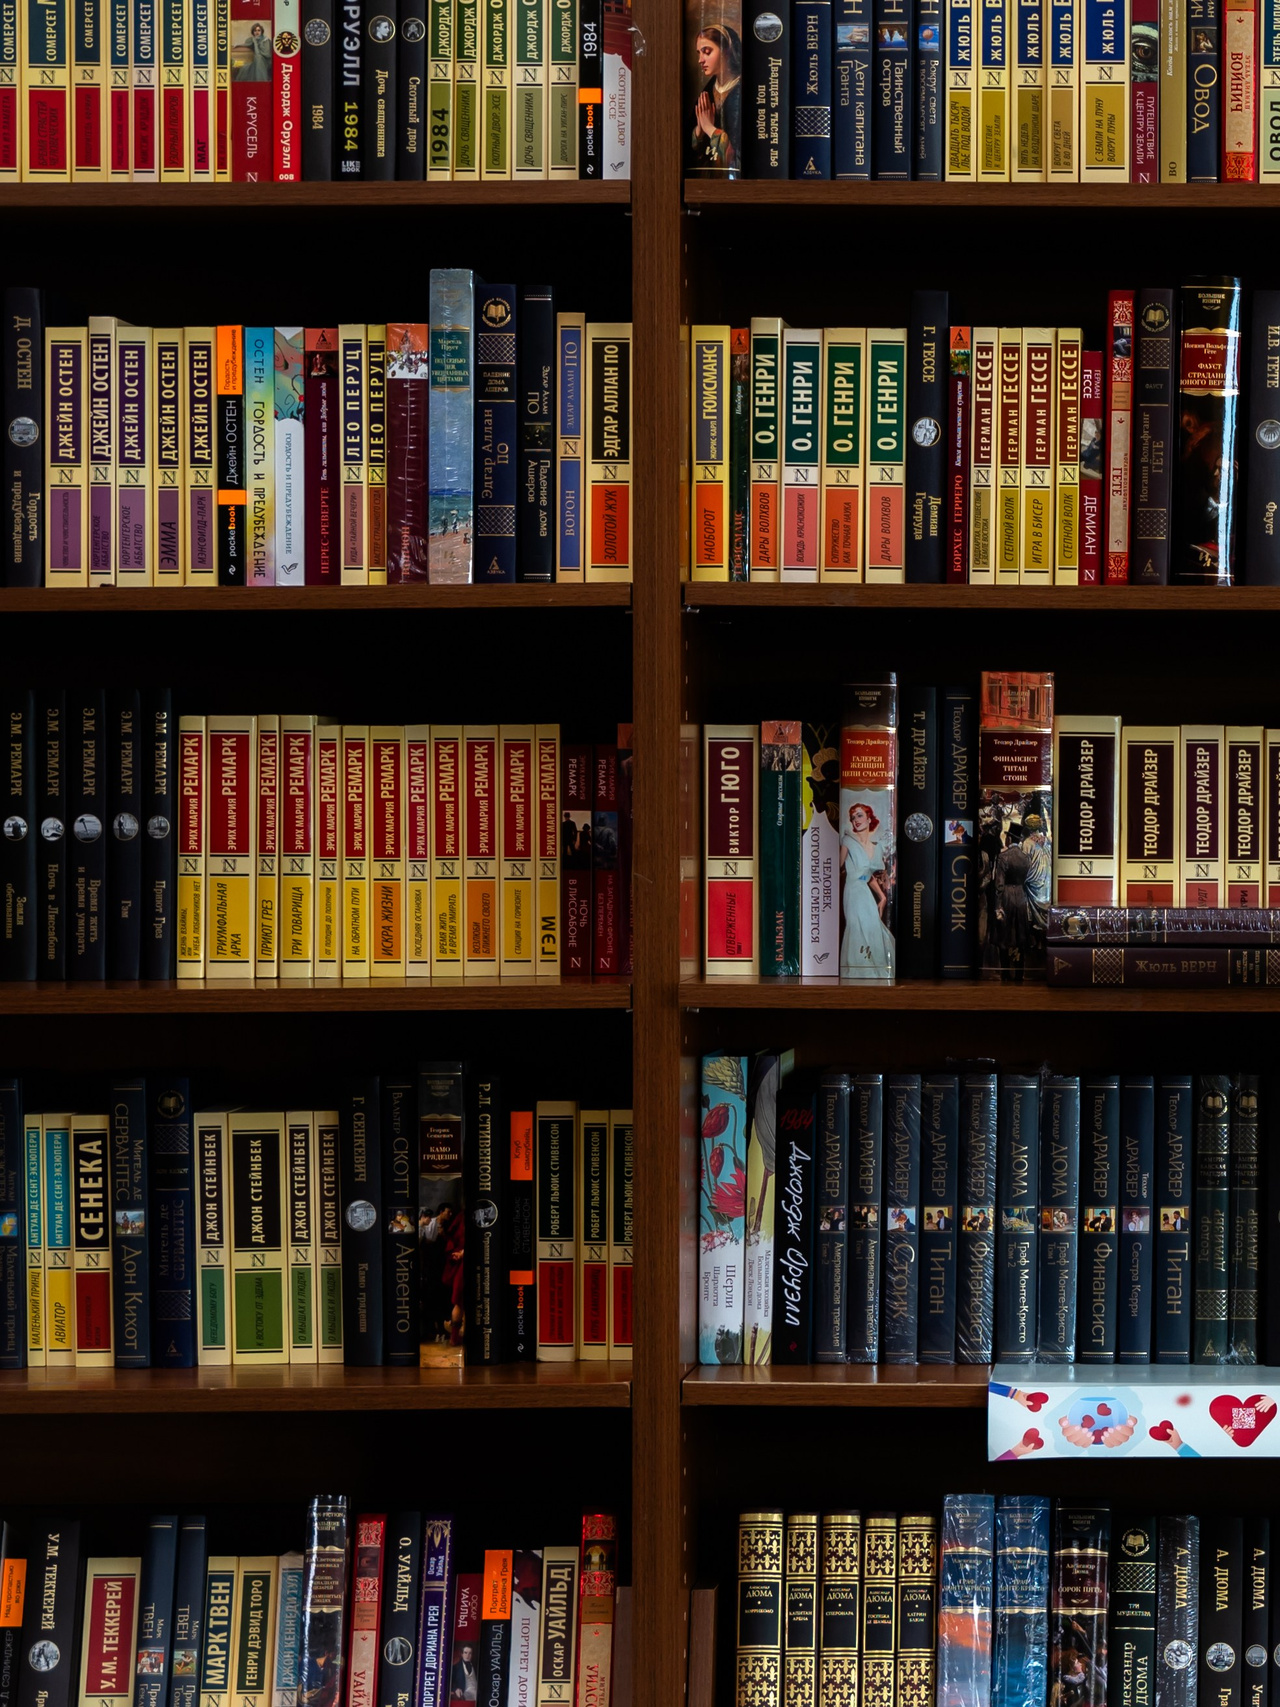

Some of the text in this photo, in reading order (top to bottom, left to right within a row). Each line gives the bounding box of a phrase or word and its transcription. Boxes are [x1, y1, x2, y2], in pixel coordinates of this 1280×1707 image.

[3, 4, 14, 61] СОМЕРСЕТ
[584, 22, 596, 59] 1984
[377, 70, 388, 157] Дочь священника
[757, 85, 766, 139] под водой
[769, 57, 782, 167] Двадцать тысяч лье
[1231, 52, 1243, 112] ВОЙНИЧ
[246, 97, 256, 158] КАРУСЕЛЬ
[281, 63, 292, 168] Джордж Оруэлл
[313, 105, 323, 129] 1984
[344, 102, 358, 151] 1984
[432, 109, 449, 163] 1984
[198, 139, 206, 163] МАГ
[254, 340, 264, 384] ОСТЕН
[703, 346, 717, 419] ГЮИСМАНС
[57, 349, 75, 458] ДЖЕЙН ОСТЕН
[347, 350, 361, 457] ЛЕО ПЕРУЦ
[604, 345, 619, 456] ЭДГАР АЛЛАН ПО
[792, 362, 812, 451] О. ГЕНРИ
[226, 400, 238, 484] Джейн ОСТЕН
[253, 401, 266, 465] ГОРДОСТЬ
[161, 521, 176, 565] ЭММА
[253, 487, 266, 578] ПРЕДУБЕЖДЕНИЕ
[566, 489, 574, 536] ВОРОН
[604, 490, 617, 560] ЗОЛОТОЙ ЖУК
[705, 508, 715, 560] НАОБОРОТ
[1084, 496, 1096, 554] ДЕМИАН
[222, 738, 236, 795] РЕМАРК
[1078, 740, 1095, 851] ТЕОДОР ДРАЙЗЕР
[721, 746, 740, 853] ВИКТОР ГЮГО
[811, 827, 821, 943] КОТОРЫЙ СМЕЕТСЯ
[217, 883, 227, 956] ТРИУМФАЛЬНАЯ
[231, 933, 241, 956] АРКА
[292, 887, 303, 955] ТРИ ТОВАРИЩА
[382, 886, 393, 955] ИСКРА ЖИЗНИ
[542, 916, 555, 955] ГЭМ
[727, 893, 736, 955] ОТВЕРЖЕННЫЕ
[80, 1140, 103, 1240] СЕНЕКА
[202, 1134, 219, 1240] ДЖОН СТЕЙНБЕК
[1012, 1142, 1028, 1198] ДЮМА
[780, 1141, 810, 1325] Джордж Оруэлл
[725, 1265, 736, 1308] Шерли
[58, 1303, 66, 1343] АВИАТОР
[394, 1554, 411, 1612] УАЙЛЬД
[546, 1568, 571, 1639] УАЙЛЬД
[746, 1588, 773, 1598] ДЮМА
[1215, 1549, 1229, 1611] А. ДЮМА
[103, 1581, 122, 1652] ТЕККЕРЕЙ
[206, 1581, 230, 1684] МАРК ТВЕН
